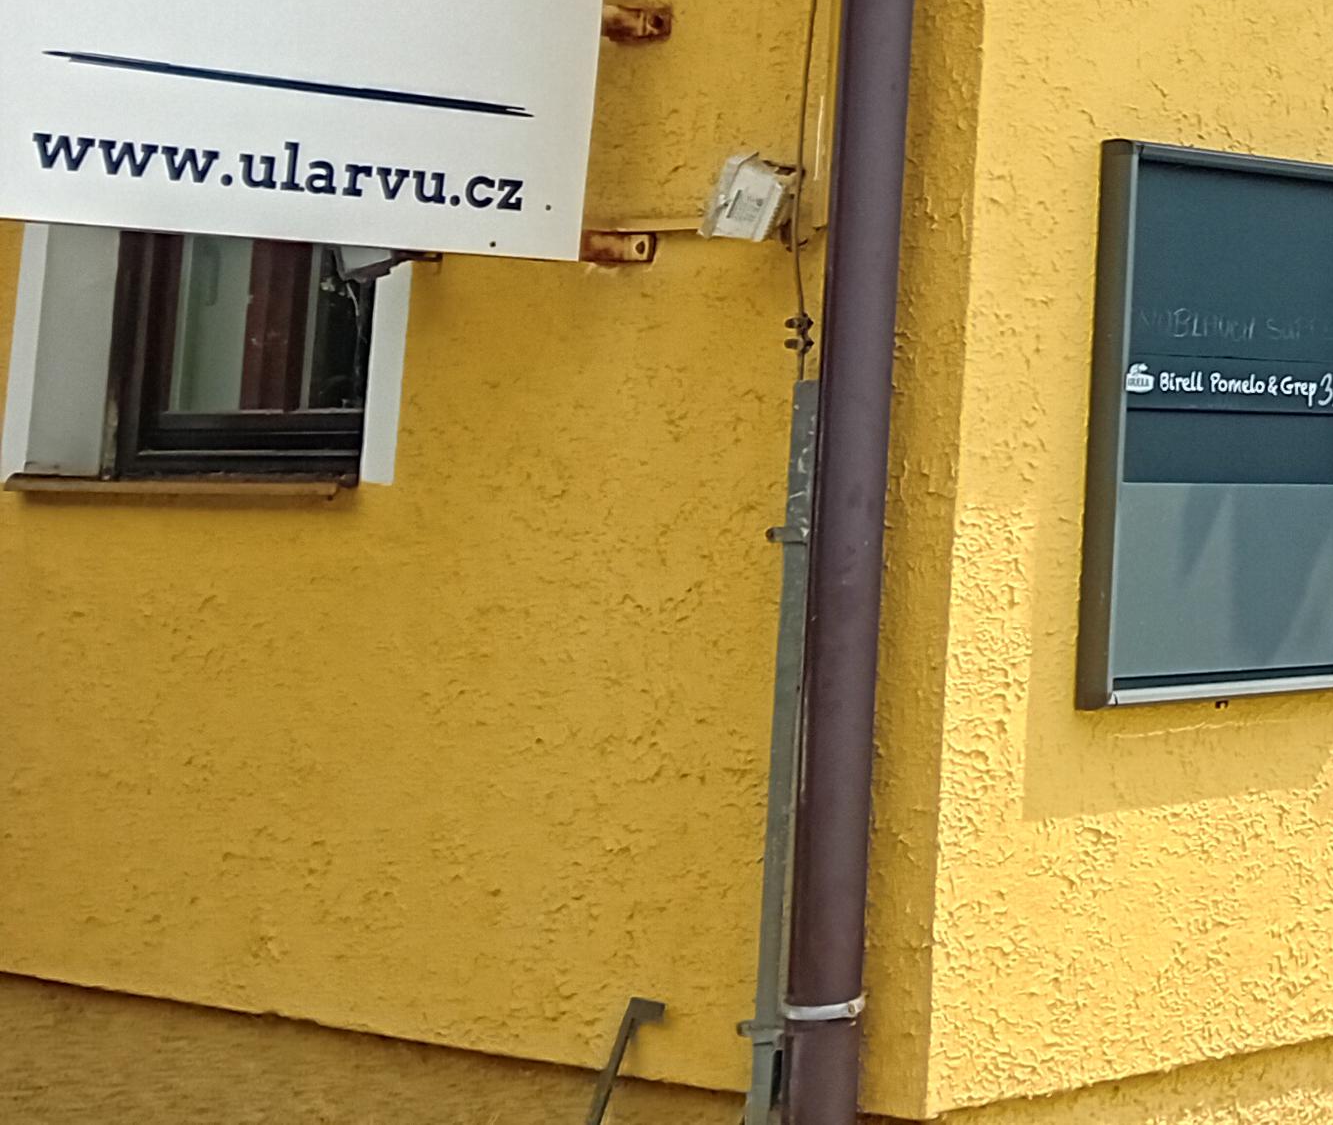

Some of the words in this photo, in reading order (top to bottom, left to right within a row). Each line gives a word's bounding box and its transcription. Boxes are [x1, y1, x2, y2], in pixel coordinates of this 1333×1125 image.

[33, 131, 524, 212] www.ularvu.cz
[1159, 371, 1204, 392] Birell
[1210, 372, 1266, 394] Pomelo
[1279, 375, 1318, 407] Grep
